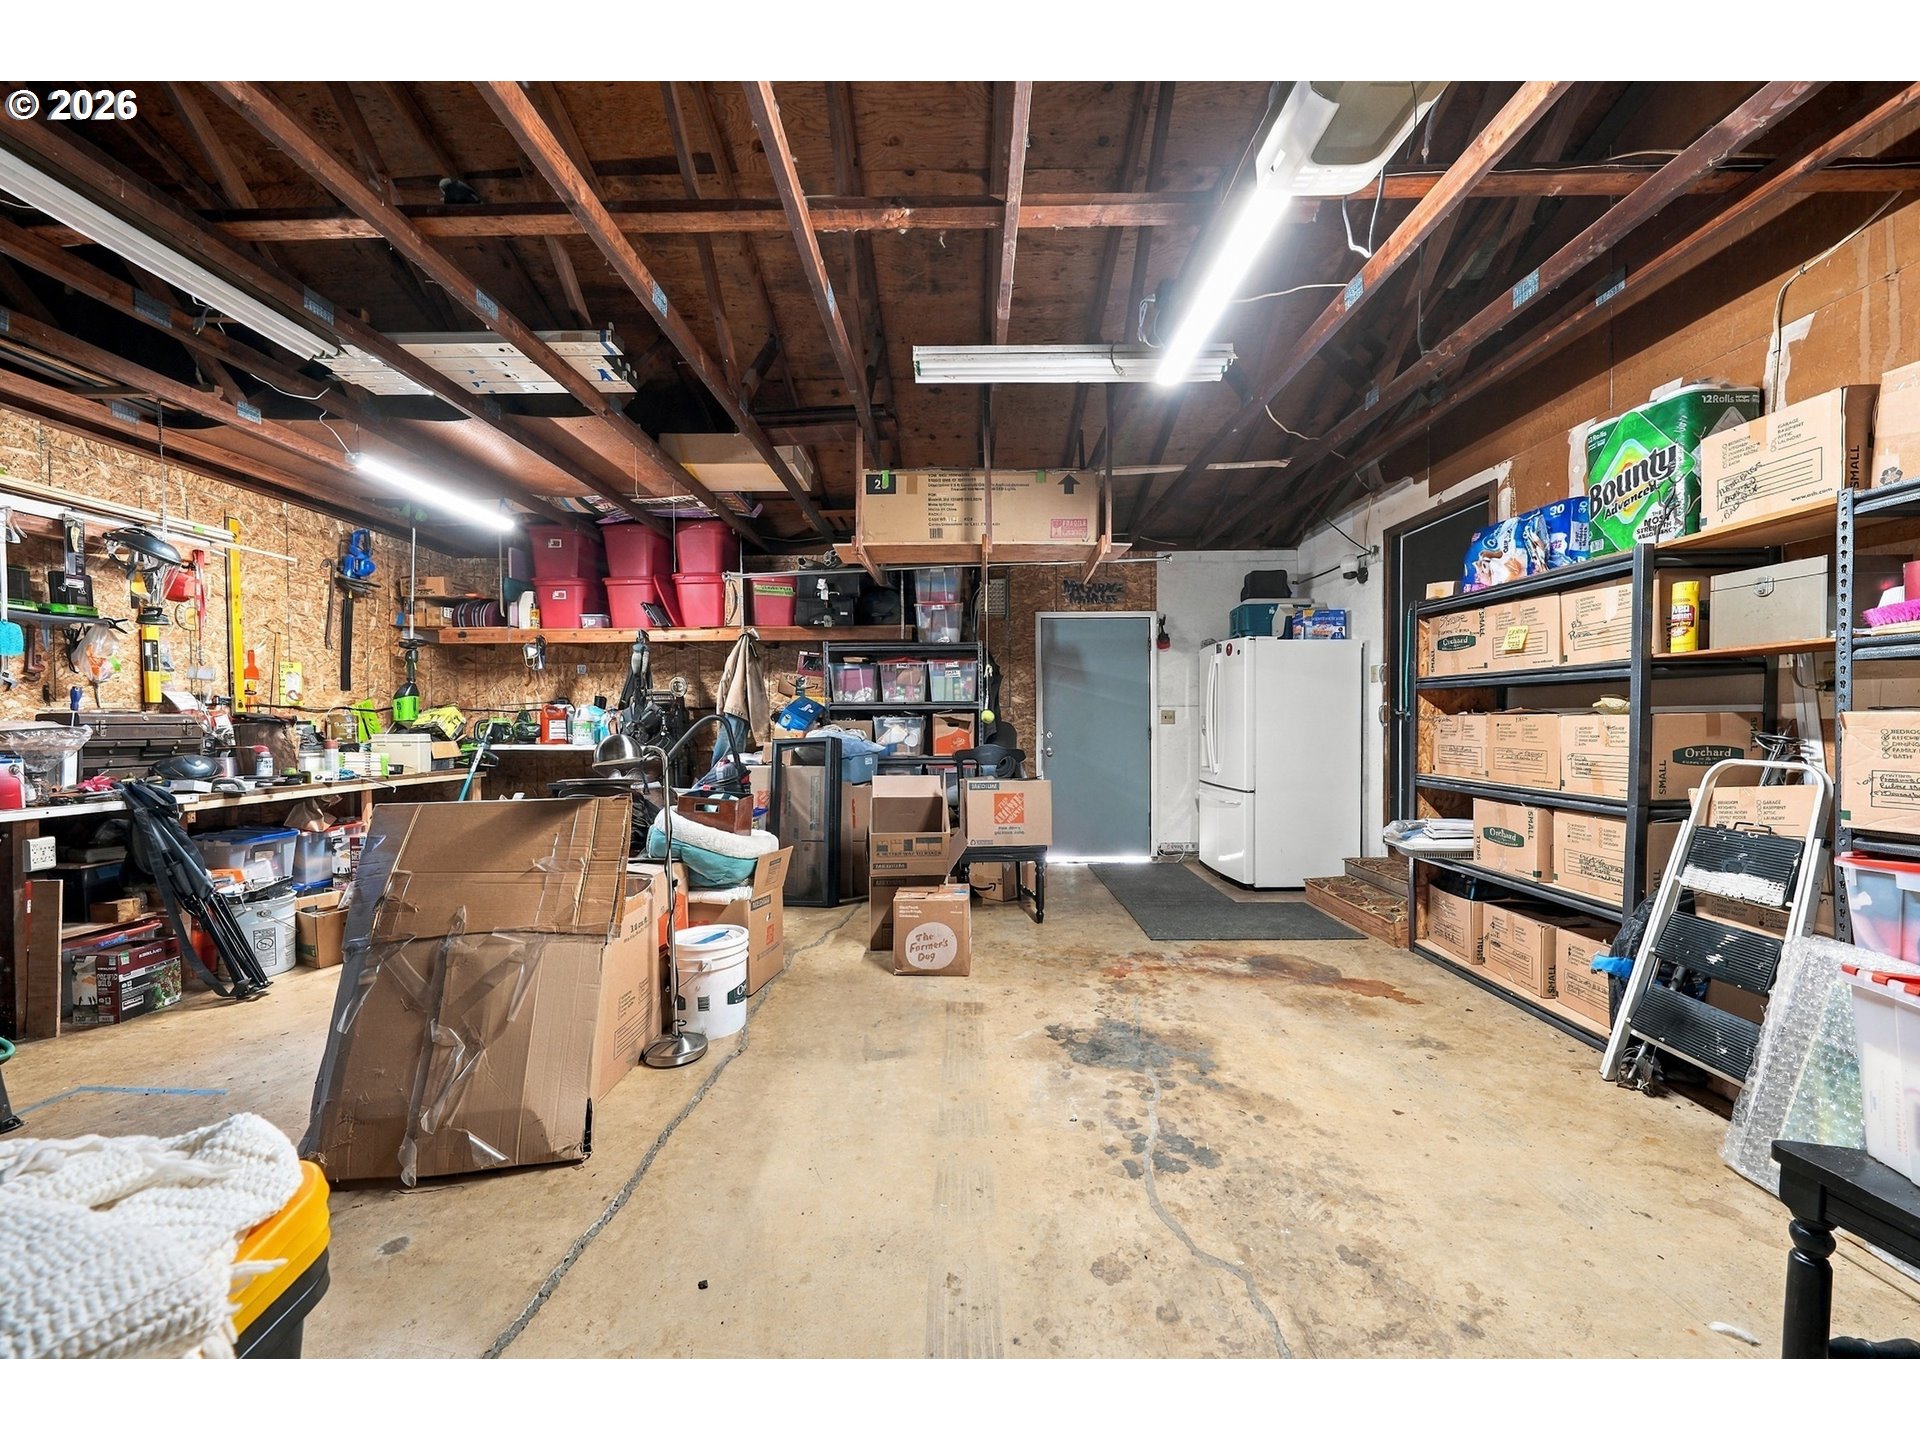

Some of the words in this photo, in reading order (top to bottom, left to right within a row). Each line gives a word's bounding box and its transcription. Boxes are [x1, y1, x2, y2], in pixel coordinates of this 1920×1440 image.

[1849, 445, 1860, 489] SMALL
[1590, 444, 1677, 521] Bounty
[1549, 503, 1565, 516] 30
[1605, 480, 1657, 520] Advanced
[1684, 746, 1732, 758] Orchard
[1658, 760, 1667, 795] SMALL
[1489, 827, 1518, 842] Orchard
[1527, 811, 1535, 841] SMALL
[909, 938, 949, 953] Farmer's
[915, 932, 935, 941] The
[917, 952, 936, 963] Dog
[1476, 937, 1484, 961] SMALL
[97, 973, 118, 981] PACIFIC
[1547, 965, 1556, 994] SMALL
